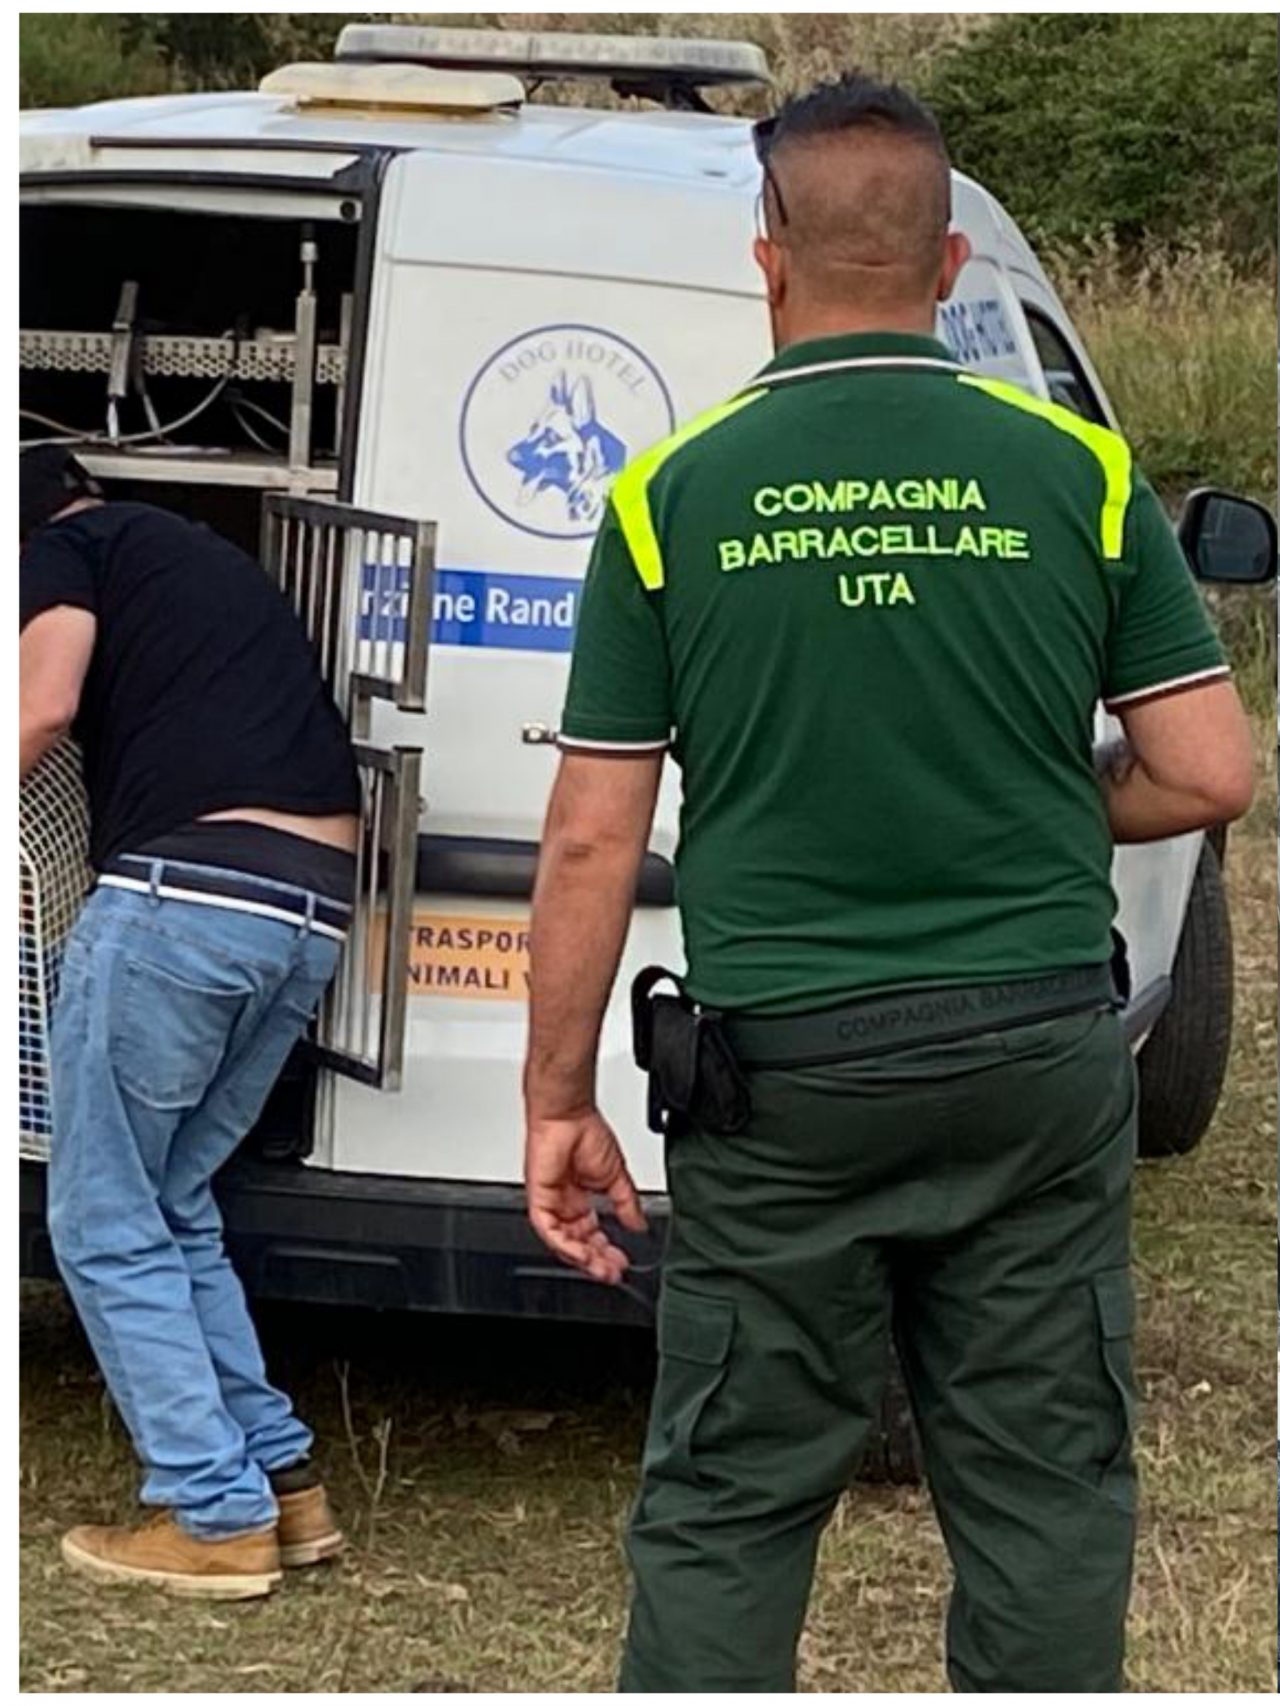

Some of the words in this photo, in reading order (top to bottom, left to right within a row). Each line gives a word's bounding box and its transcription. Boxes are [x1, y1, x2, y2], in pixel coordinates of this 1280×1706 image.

[499, 341, 557, 384] DOG
[565, 340, 646, 394] HOTEL
[753, 478, 987, 516] COMPAGNIA
[718, 525, 1030, 572] BARRACELLARE
[486, 587, 575, 628] Rand
[838, 572, 916, 607] UTA
[408, 924, 532, 953] RASPOR
[407, 963, 510, 990] NIMALI
[836, 993, 976, 1042] COMPAGNIA
